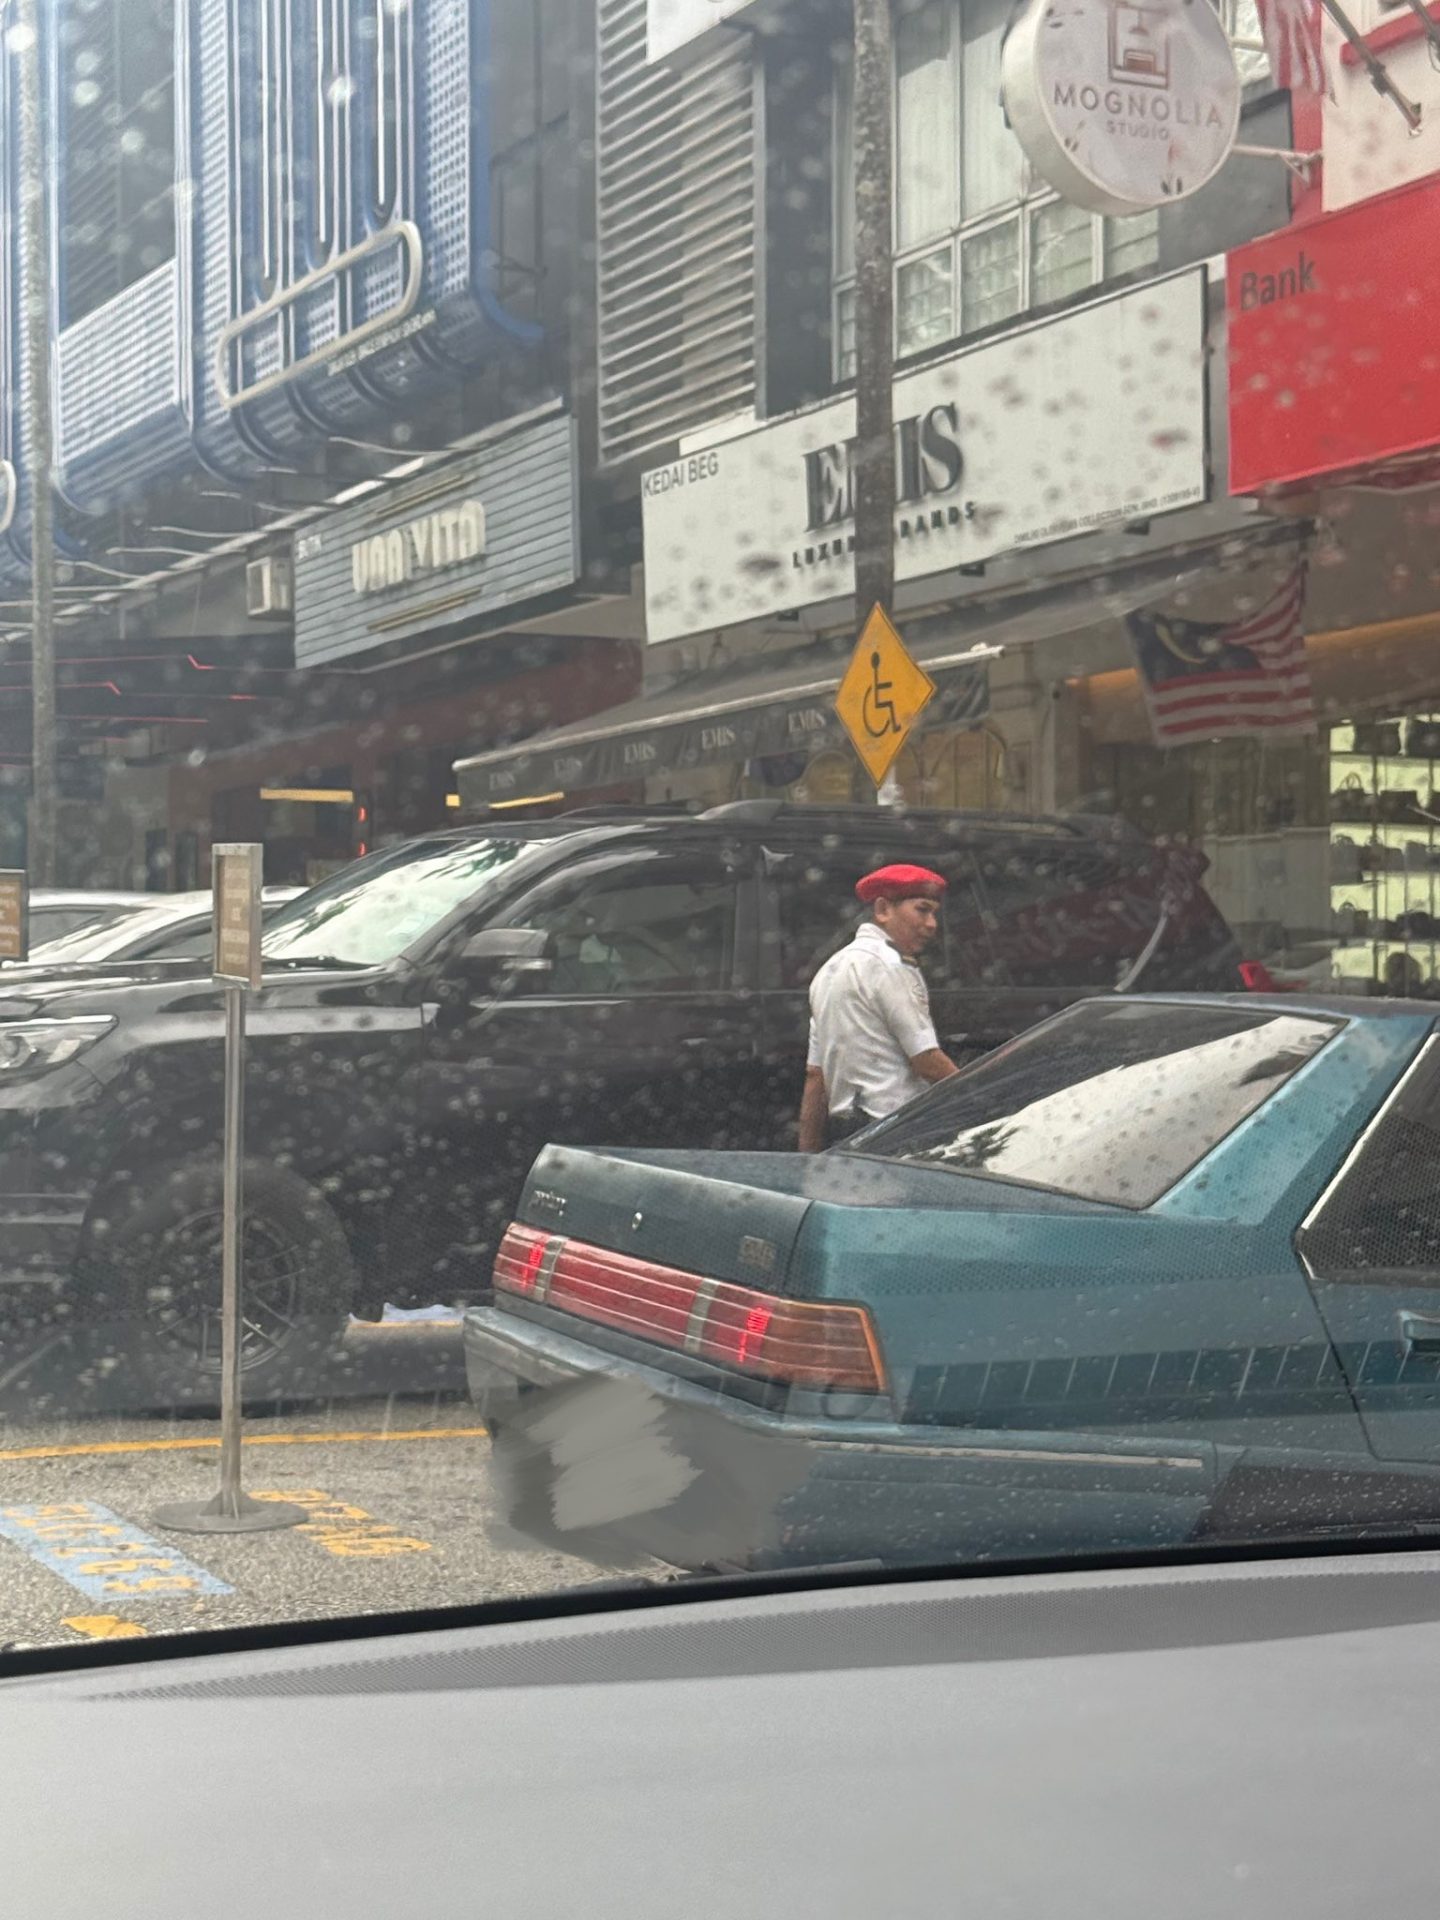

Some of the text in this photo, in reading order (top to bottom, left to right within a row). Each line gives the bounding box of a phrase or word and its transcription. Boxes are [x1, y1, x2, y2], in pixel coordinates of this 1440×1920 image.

[1054, 83, 1223, 129] MOGNOLIA
[1106, 119, 1170, 141] STUDIO
[1240, 250, 1315, 310] Bank
[642, 451, 720, 497] KEDAI BEG
[801, 401, 964, 532] EIS
